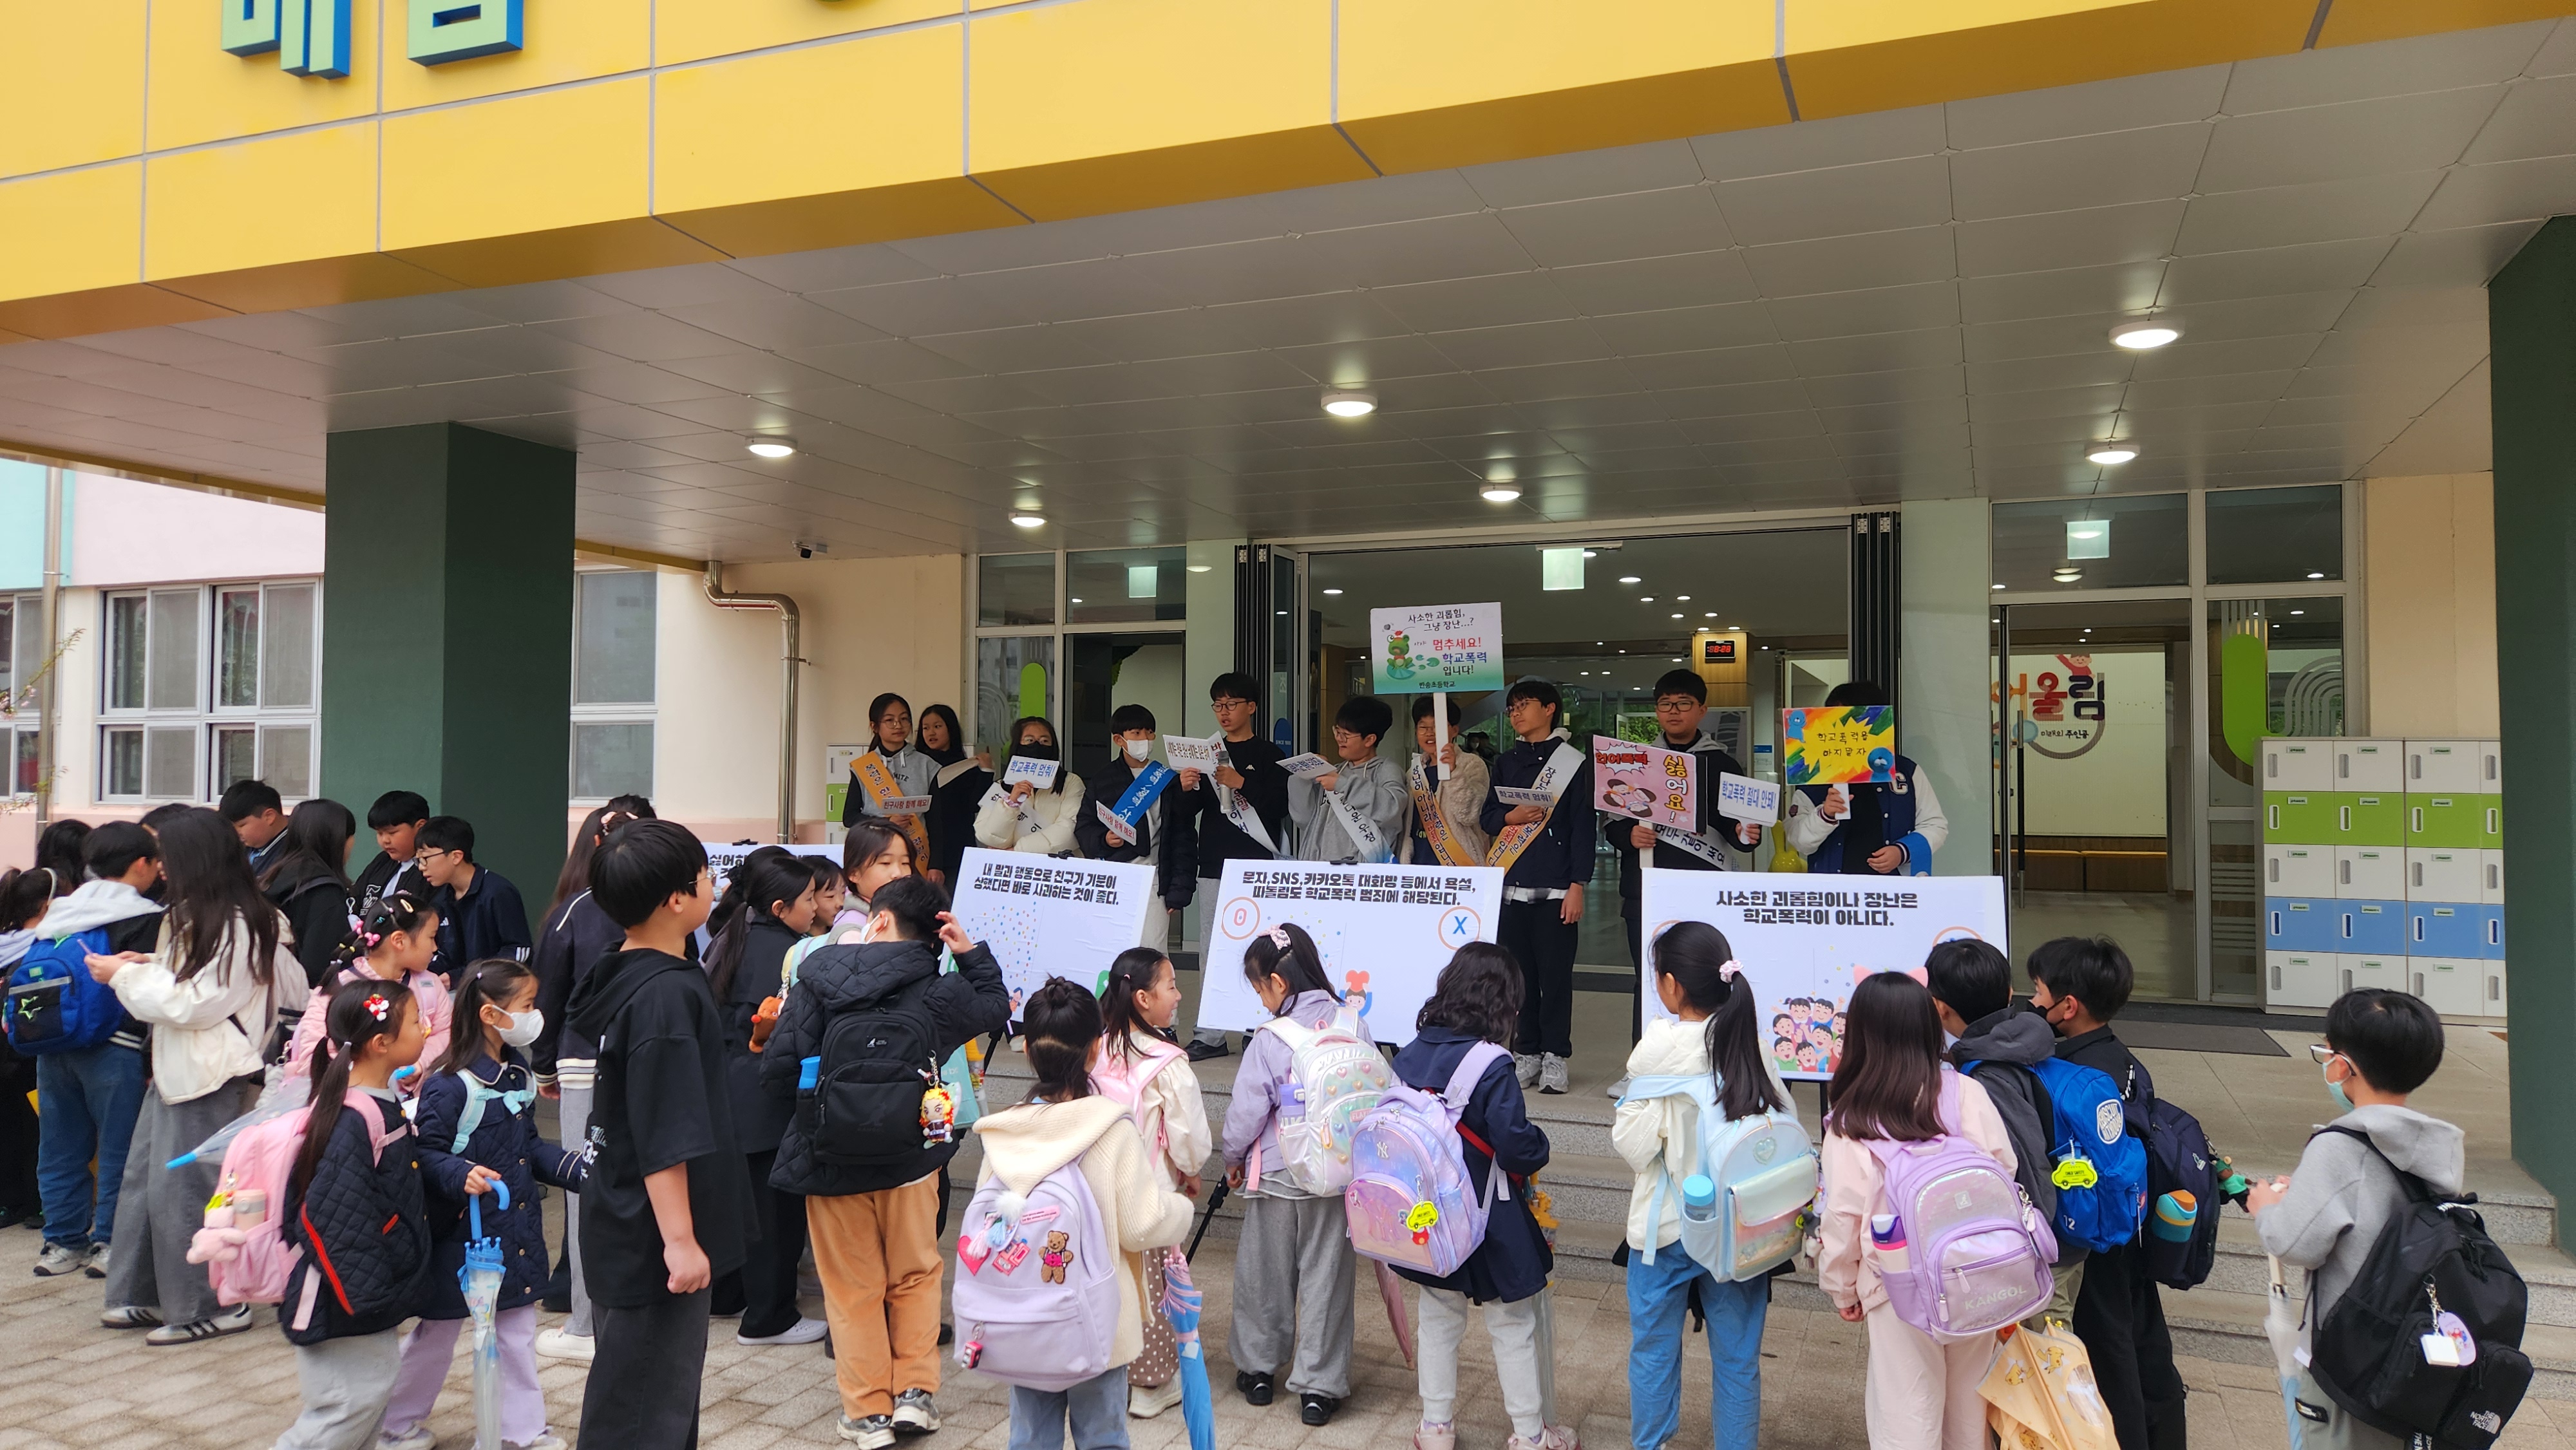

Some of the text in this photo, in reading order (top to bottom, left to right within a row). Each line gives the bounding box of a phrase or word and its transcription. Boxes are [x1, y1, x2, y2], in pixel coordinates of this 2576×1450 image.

[1408, 609, 1465, 623] 사소한 괴롭힘,
[1424, 623, 1440, 631] 그냥
[1433, 637, 1481, 650] 멈추세요!
[1443, 652, 1487, 665] 학교폭력
[1443, 665, 1473, 676] 입니다!
[2065, 730, 2089, 739] 주인공
[1596, 753, 1647, 764] 언어폭력
[1010, 760, 1056, 777] 학교폭력 멈춰!
[1499, 791, 1551, 802] 학교폭력 멈춰!
[1663, 755, 1687, 823] 싫어요!
[1722, 780, 1746, 805] 학교폭력
[1747, 786, 1759, 807] 절대
[884, 801, 904, 809] 친구사랑
[906, 800, 915, 808] 함께
[1417, 794, 1432, 822] 아니라
[983, 863, 1117, 889] 내 말과 행동으로 친구가 기분이
[1358, 874, 1397, 889] 대화방
[1400, 876, 1441, 890] 등에서
[1444, 877, 1476, 893] 욕설,
[974, 877, 1119, 906] 상했다면 바로 사과하는 것이 좋다.
[1253, 886, 1461, 906] 따돌림도 학교폭력 범죄에 해당된다.
[1716, 890, 1918, 909] 사소한 괴롭힘이나 장난은
[1743, 908, 1895, 927] 학교폭력이 아니다.
[1964, 1285, 2027, 1311] KANGOL
[2470, 1411, 2491, 1424] NORTH
[2472, 1420, 2487, 1429] FACE
